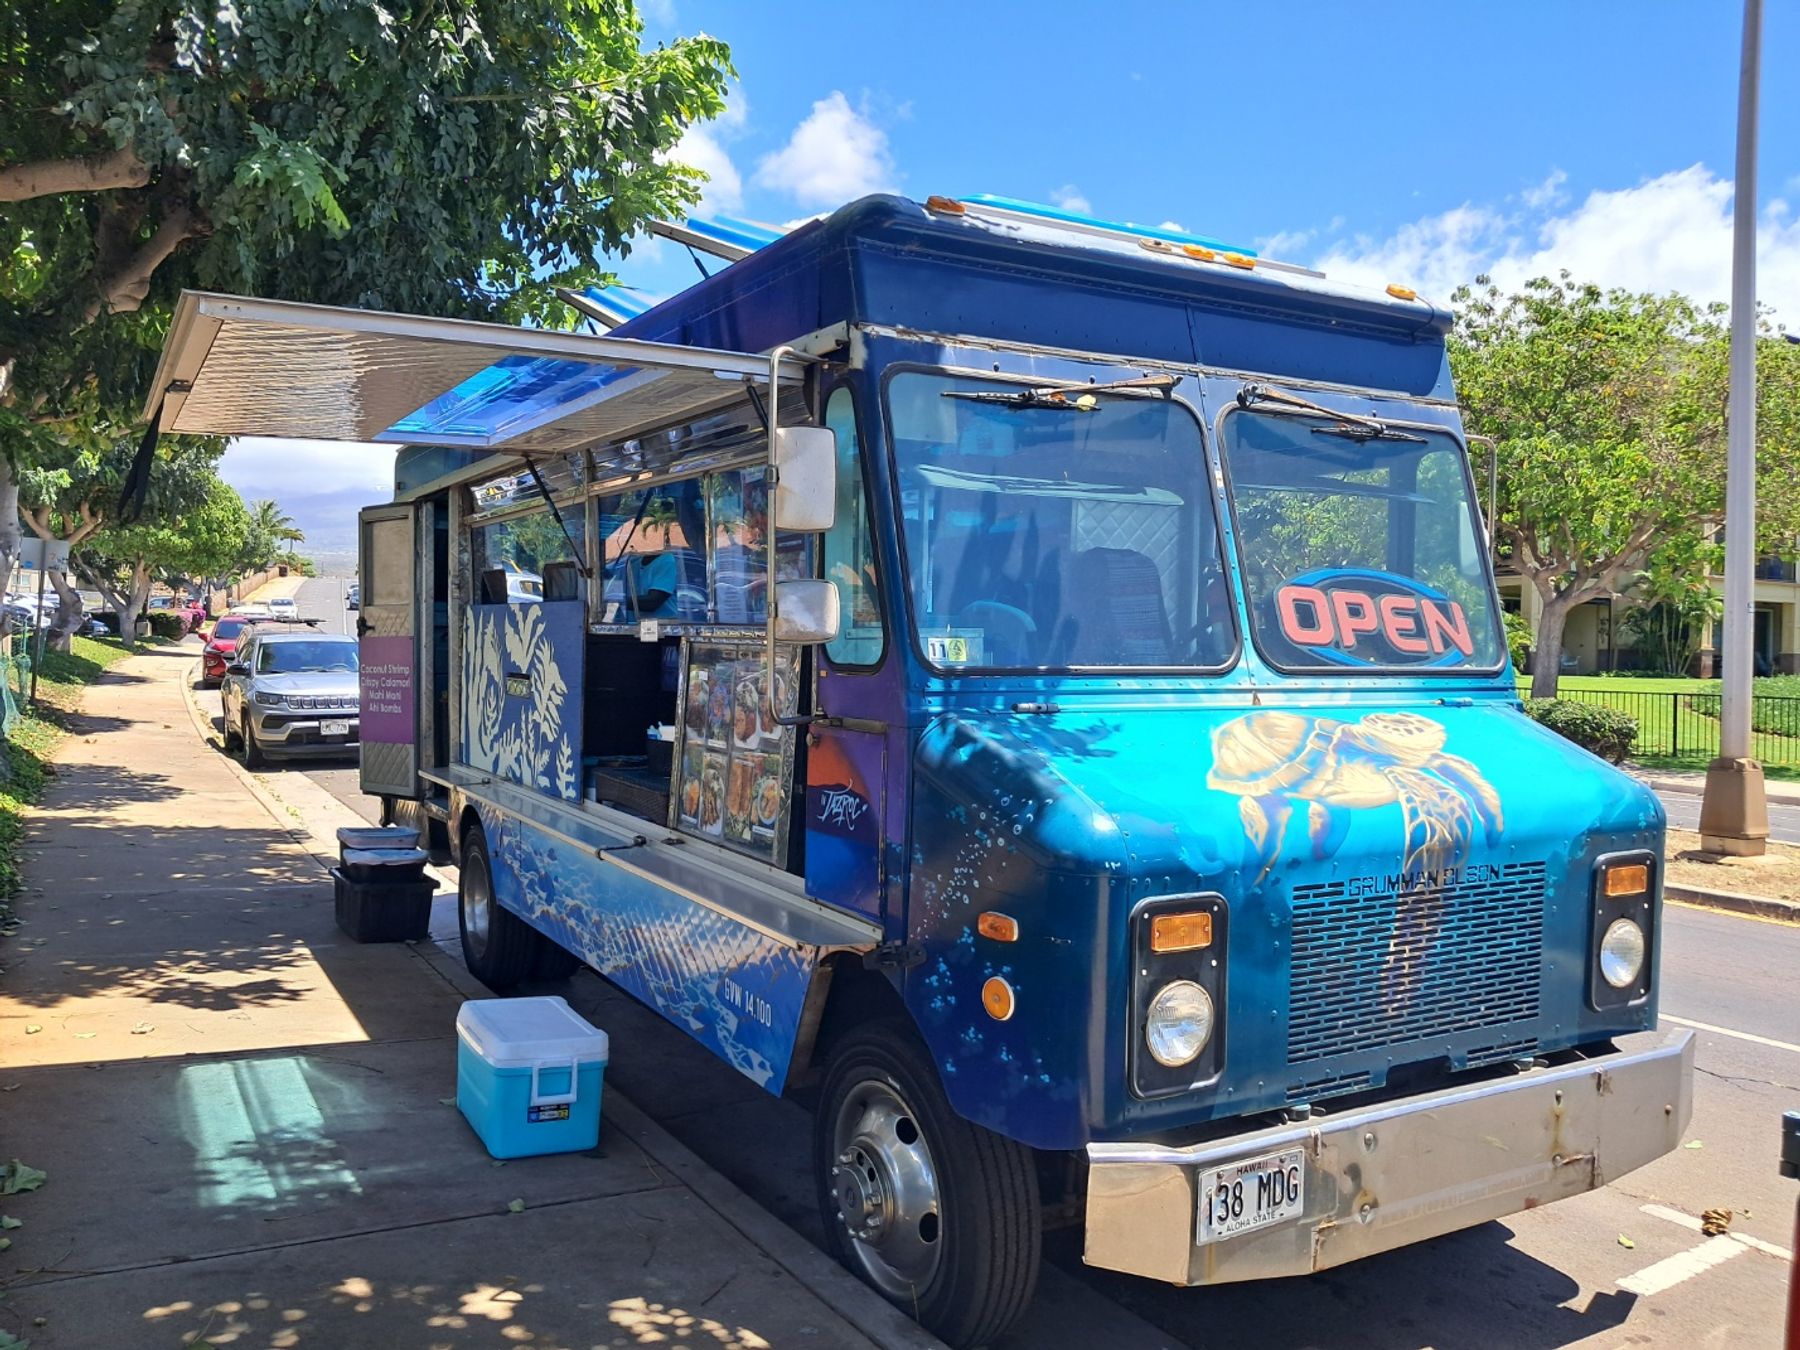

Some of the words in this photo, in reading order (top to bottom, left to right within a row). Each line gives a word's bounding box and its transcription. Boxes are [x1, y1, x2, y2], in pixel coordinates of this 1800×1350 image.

[1278, 586, 1474, 656] OPEN
[361, 664, 387, 674] Coconut
[388, 664, 410, 677] Shrimp
[361, 677, 380, 689] Crispy
[380, 677, 411, 688] Calamari
[369, 689, 385, 700] Mahi
[386, 689, 402, 700] Mahi
[369, 701, 380, 713] Ahi
[1348, 868, 1438, 897] GRUMMAN
[1443, 863, 1500, 886] OLSON
[724, 977, 743, 1008] GVW
[1236, 1160, 1268, 1175] HAWAII
[1208, 1181, 1244, 1226] 138
[1257, 1166, 1299, 1212] MDG
[1226, 1218, 1251, 1233] ALOHA
[1252, 1210, 1276, 1224] STATE
